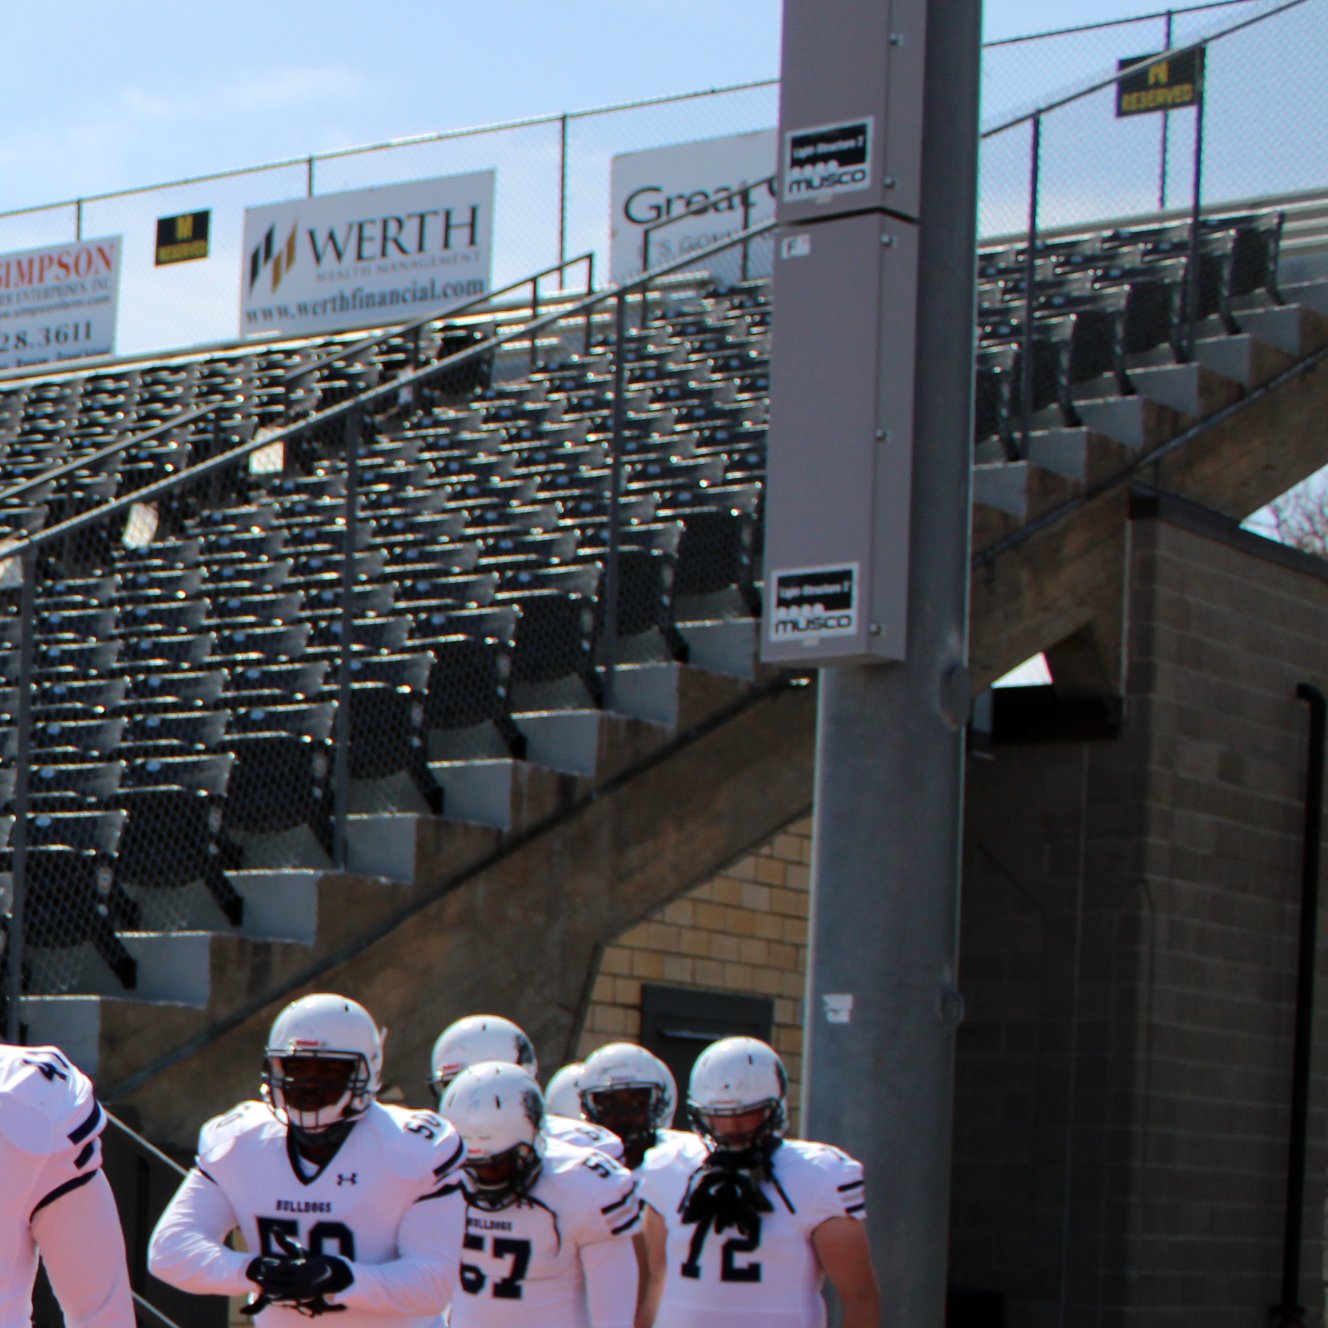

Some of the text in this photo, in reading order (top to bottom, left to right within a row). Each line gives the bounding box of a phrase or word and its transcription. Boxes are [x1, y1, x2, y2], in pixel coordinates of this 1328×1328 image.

[307, 204, 481, 266] WERTH
[377, 250, 482, 277] MANAGEMENT
[246, 278, 486, 323] www.werthfinancial.com
[275, 1199, 333, 1213] BULLDOGS
